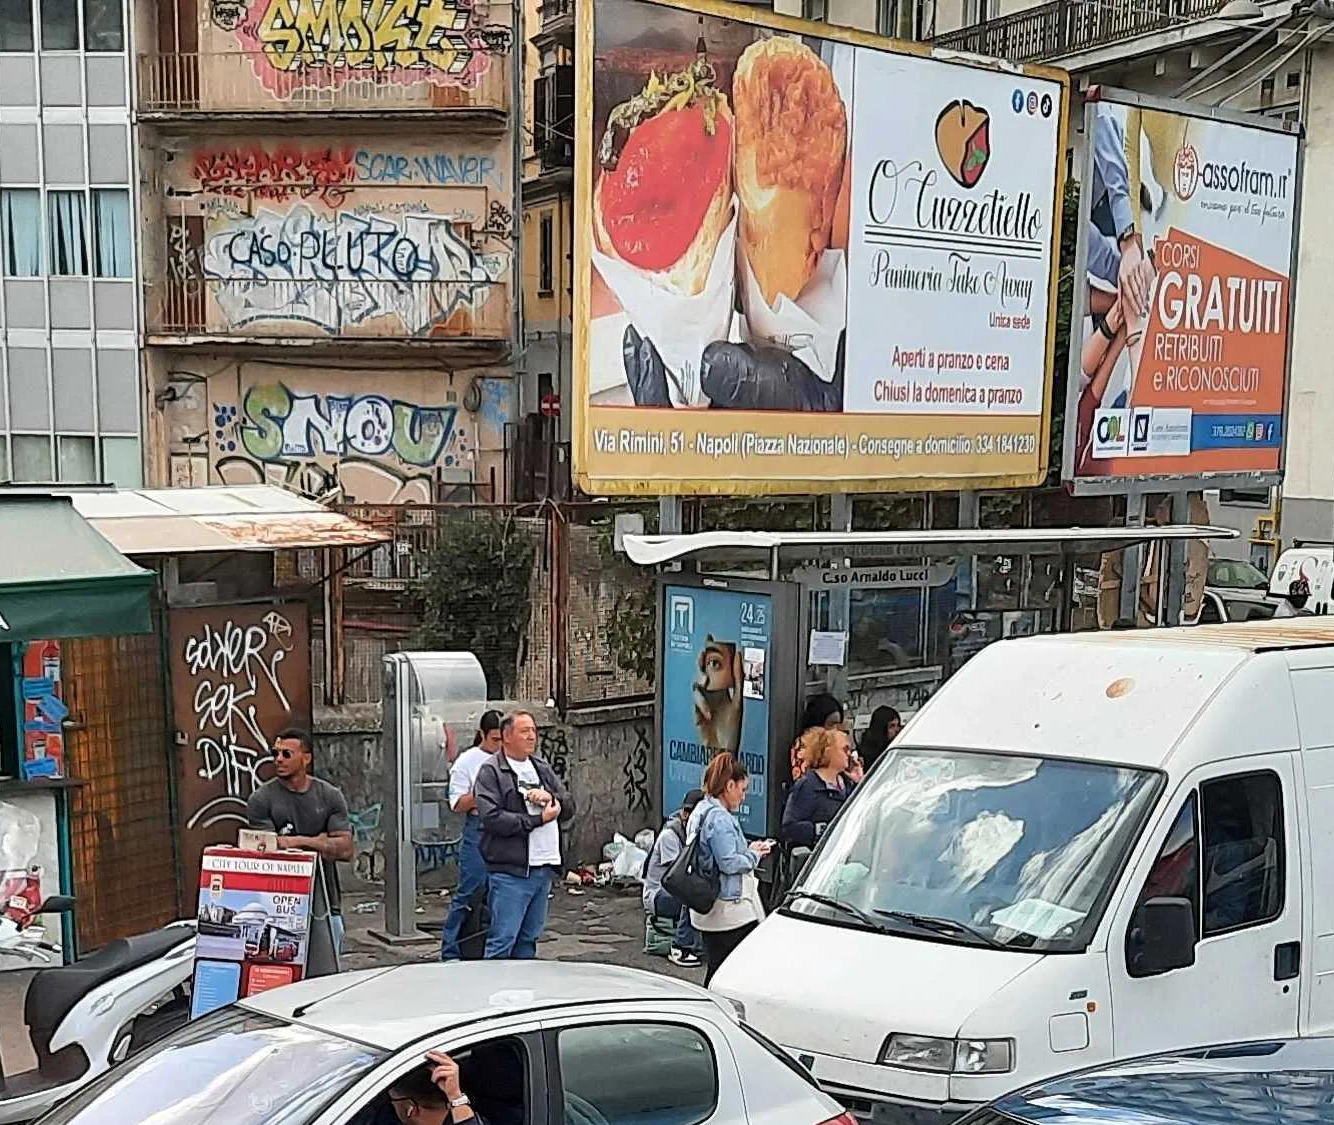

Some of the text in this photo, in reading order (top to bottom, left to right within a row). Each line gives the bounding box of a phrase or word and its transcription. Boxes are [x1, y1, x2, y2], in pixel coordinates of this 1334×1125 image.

[298, 230, 417, 275] PLUTO
[1161, 242, 1200, 269] CORSI
[1158, 271, 1283, 334] GRATUITI
[892, 345, 1009, 374] Aperti a pranzo e cena
[1153, 366, 1260, 392] e RICONOSCIUTI
[925, 382, 976, 403] domenica
[979, 390, 986, 402] a
[988, 388, 1023, 408] pranzo
[594, 429, 616, 452] Via
[619, 429, 667, 454] Rimini,
[670, 432, 686, 454] 51
[696, 432, 739, 458] Napoli
[740, 432, 785, 459] (Piazza
[787, 433, 849, 459] Nazionale)
[858, 433, 915, 460] Consegne
[916, 440, 922, 453] a
[975, 434, 994, 454] 334
[822, 569, 928, 584] C.so Arnaldo Lucci
[212, 859, 304, 874] CITY TOUR OF NAPLES
[273, 895, 300, 905] OPEN
[276, 905, 296, 914] BUS
